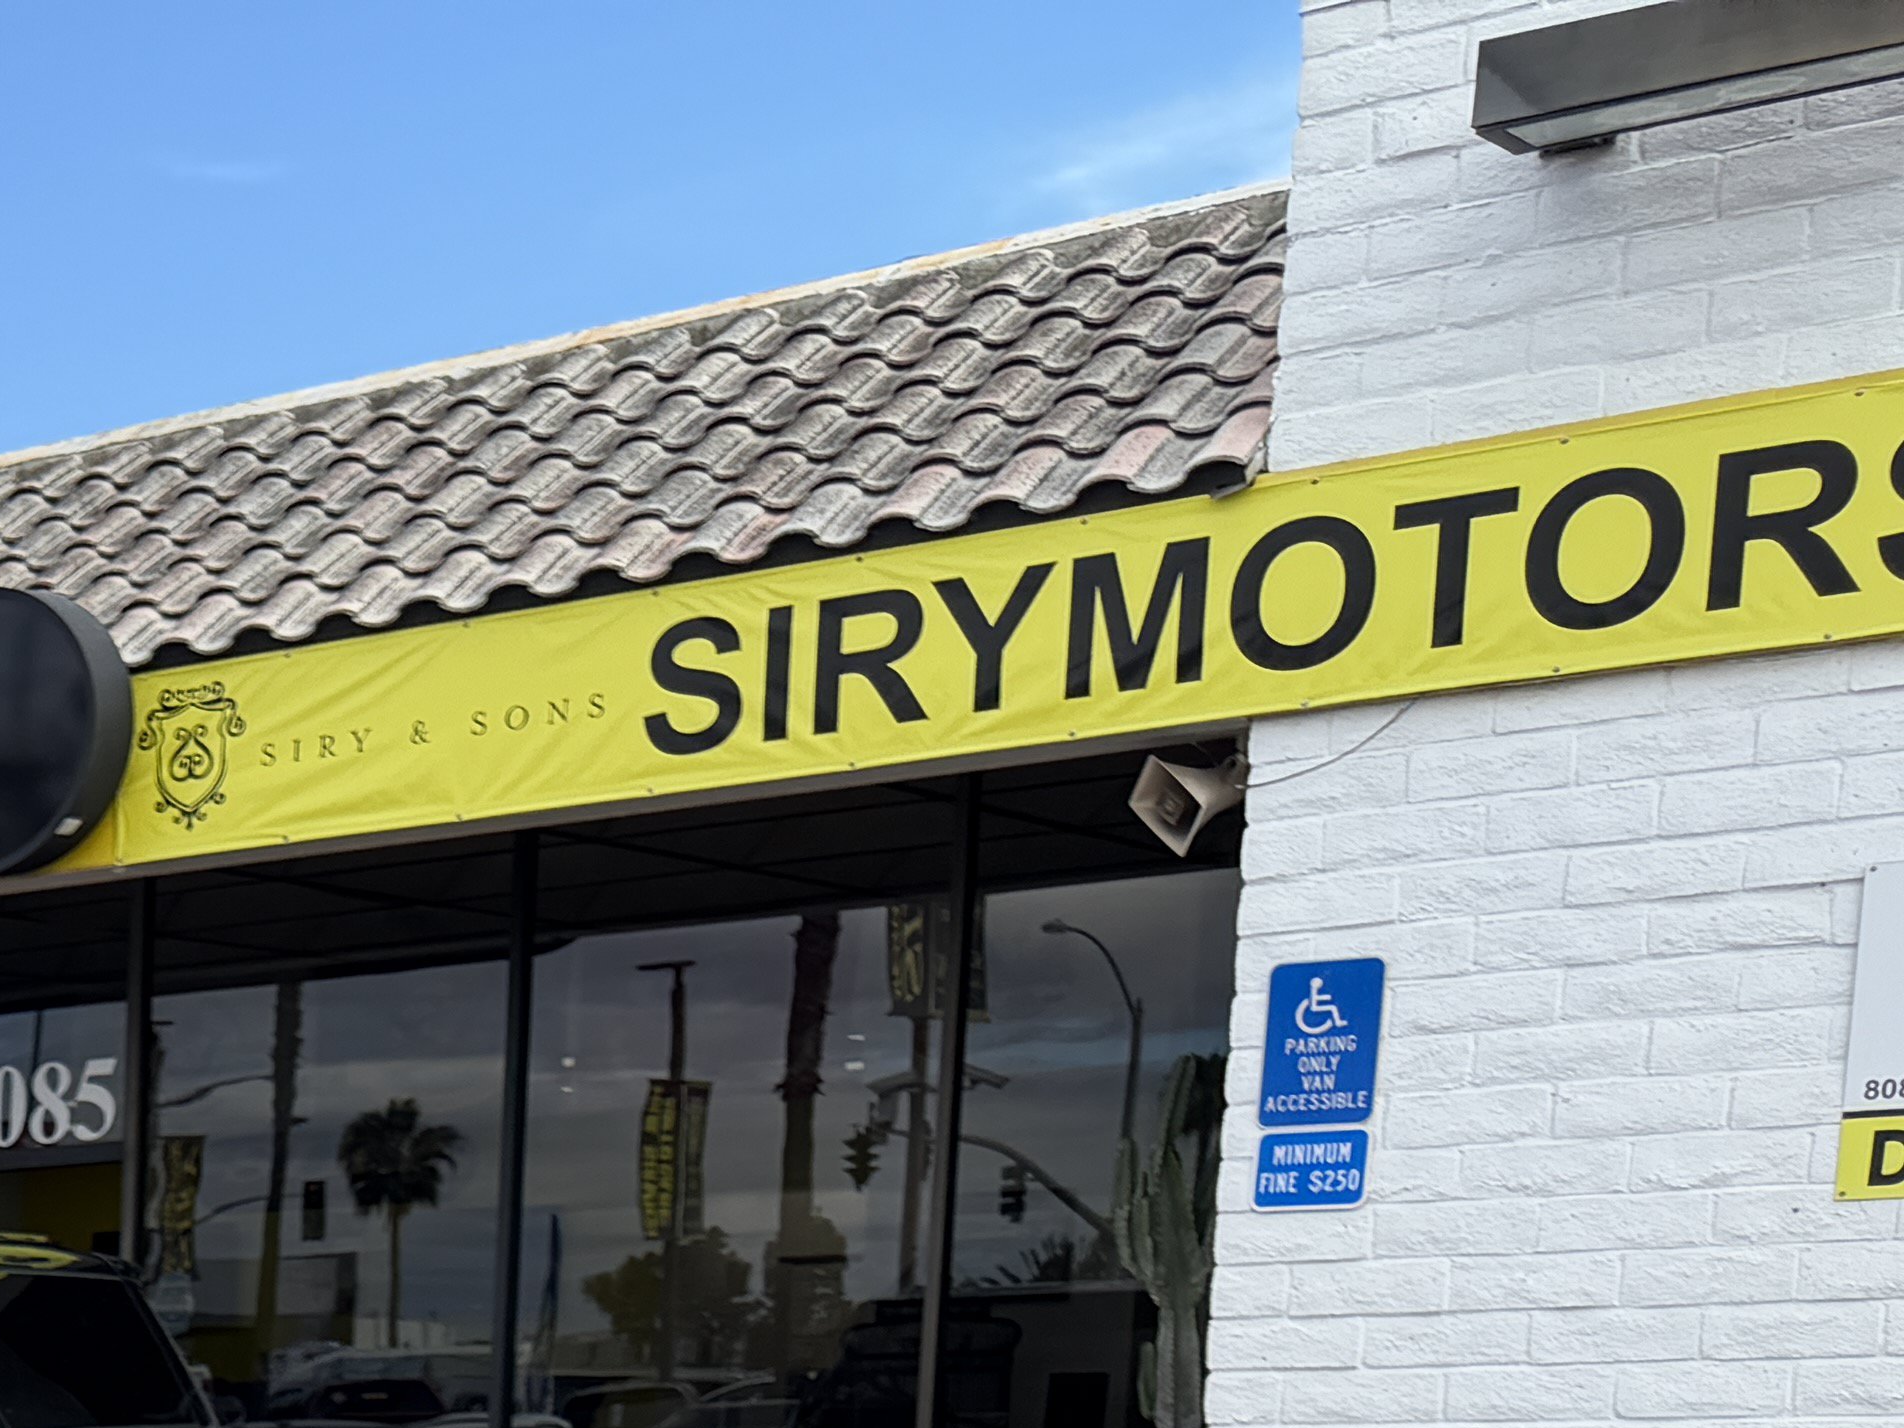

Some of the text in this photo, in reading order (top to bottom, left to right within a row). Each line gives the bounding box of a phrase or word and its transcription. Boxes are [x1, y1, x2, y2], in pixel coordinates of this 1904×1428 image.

[643, 434, 1904, 754] SIRYMOTOR
[259, 693, 607, 767] SIRY & SONS
[1285, 1034, 1357, 1055] PARKING
[1297, 1055, 1341, 1073] ONLY
[1301, 1074, 1335, 1091] VAN
[1264, 1091, 1368, 1112] ACCESSIBLE
[1272, 1142, 1352, 1166] MINIMUM
[1258, 1169, 1361, 1194] FINE $250
